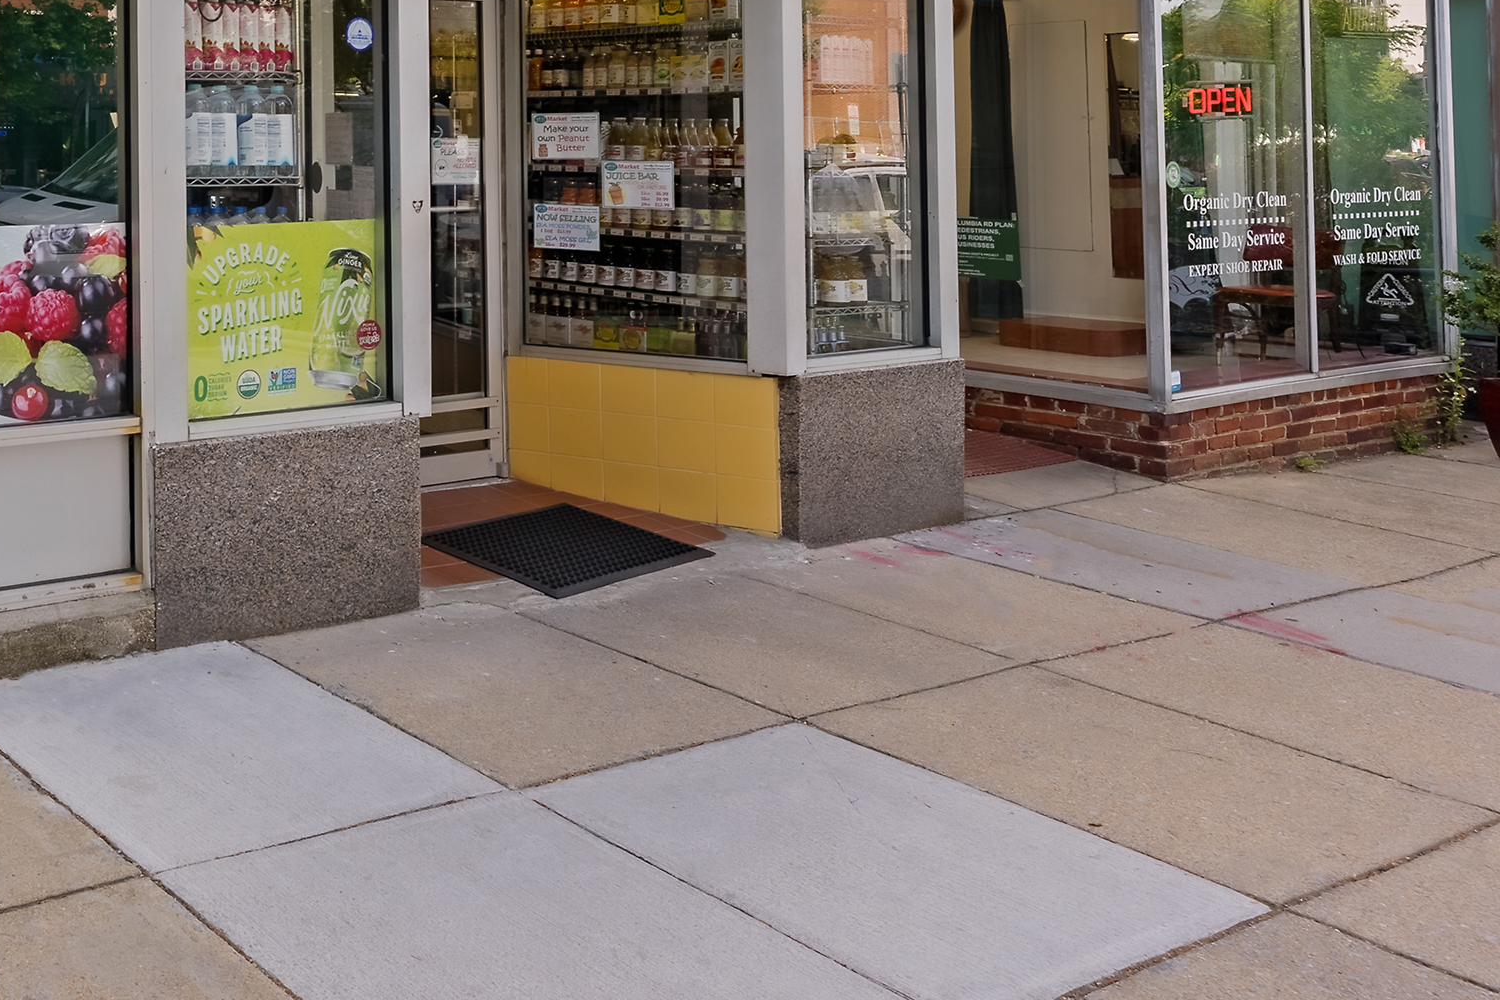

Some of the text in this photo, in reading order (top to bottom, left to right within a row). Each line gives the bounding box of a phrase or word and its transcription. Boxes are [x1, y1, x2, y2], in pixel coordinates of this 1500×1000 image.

[1189, 87, 1252, 114] OPEN
[543, 125, 568, 133] Make
[558, 134, 590, 142] Peanut
[556, 144, 586, 152] Butter
[605, 171, 660, 181] JUICE BAR
[1183, 190, 1287, 215] Organic Dry Clean
[1330, 186, 1421, 208] Organic Dry Clean
[536, 213, 597, 224] NOW SELLING
[958, 227, 1001, 236] EDESTRIANS,
[1187, 228, 1286, 252] Same Day Service
[1334, 221, 1420, 243] Same Day Service
[958, 241, 995, 249] USINESSES
[202, 242, 290, 286] UPGRADE
[337, 258, 363, 269] GINGER
[1333, 248, 1422, 266] WASH & FOLD SERVICE
[1189, 258, 1283, 278] EXPERT SHOE REPAIR
[233, 272, 263, 296] your
[197, 288, 303, 336] SPARKLING
[220, 324, 282, 364] WATER
[194, 375, 208, 402] 0
